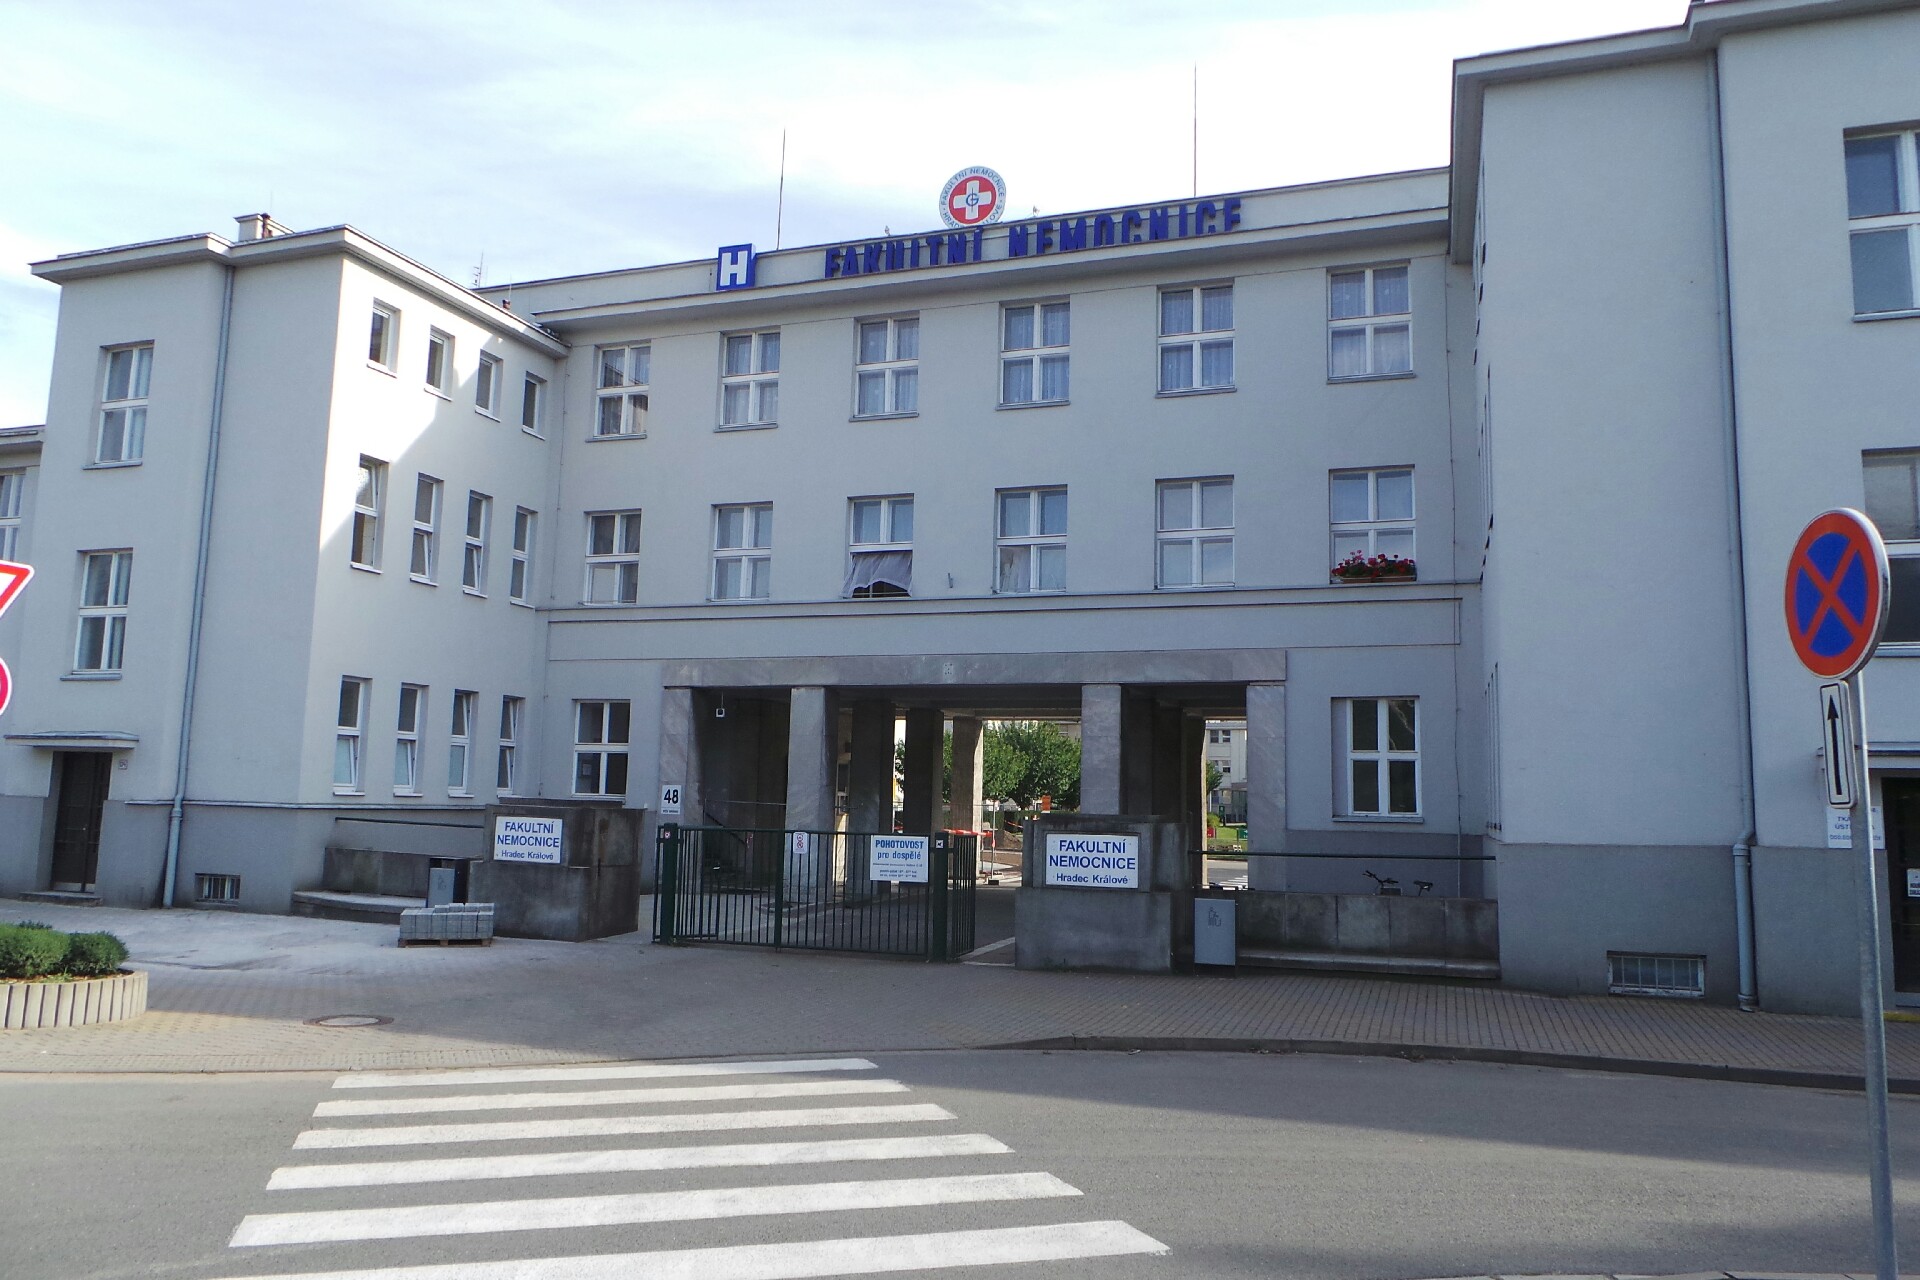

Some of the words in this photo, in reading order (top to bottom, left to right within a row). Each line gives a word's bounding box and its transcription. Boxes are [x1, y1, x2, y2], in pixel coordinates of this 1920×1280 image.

[969, 167, 1005, 198] NEMOCNICE
[942, 211, 961, 229] HRAD
[1009, 198, 1241, 257] NEMOCNICE
[720, 251, 748, 287] H
[663, 788, 679, 804] 48
[505, 821, 554, 834] FAKULTNÍ
[497, 834, 560, 848] NEMOCNICE
[875, 839, 924, 849] POHOTOVOST
[1059, 838, 1126, 854] FAKULTNÍ
[501, 850, 525, 859] Hradec
[527, 851, 554, 860] Králové
[877, 852, 890, 860] pro
[892, 851, 922, 861] dospělé
[1049, 854, 1136, 870] NEMOCNICE
[1056, 873, 1089, 883] Hradec
[1092, 874, 1129, 884] Králové
